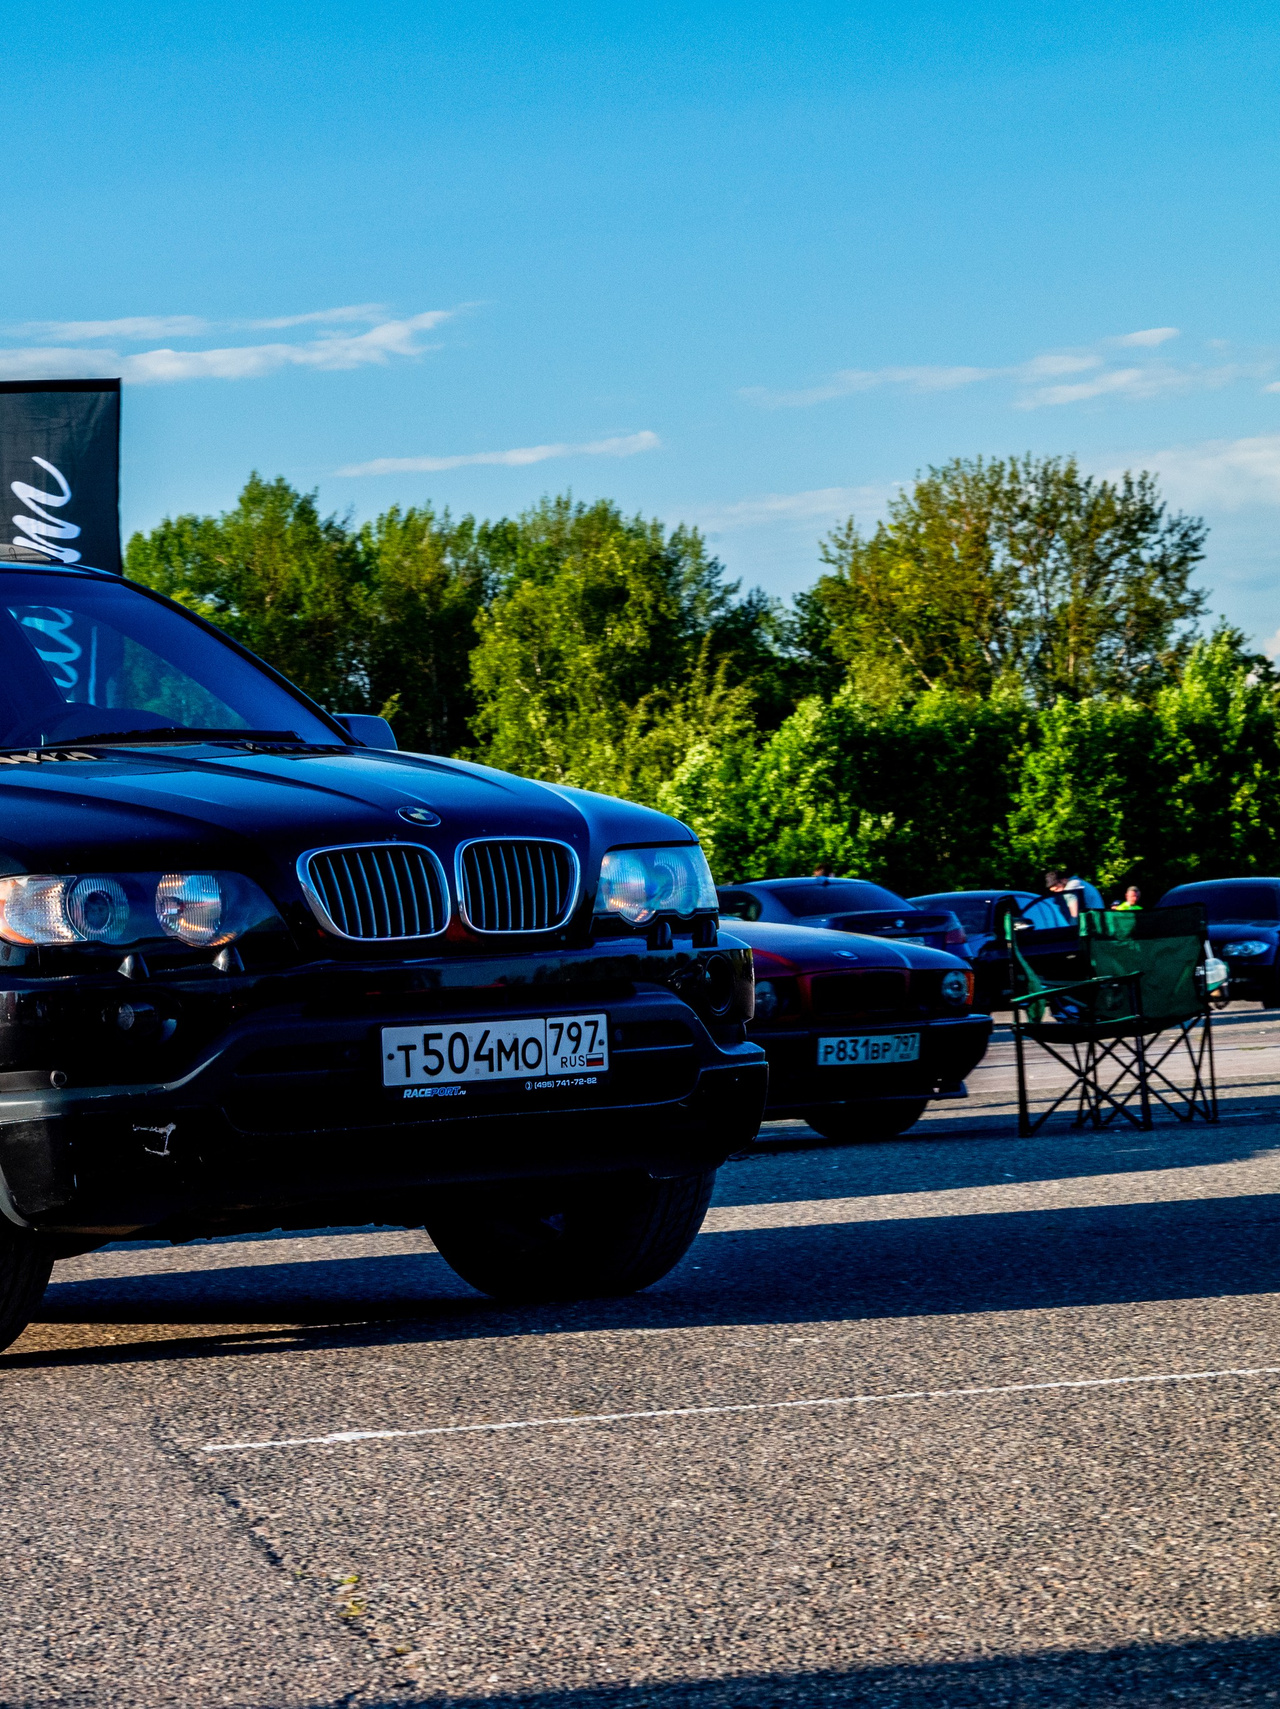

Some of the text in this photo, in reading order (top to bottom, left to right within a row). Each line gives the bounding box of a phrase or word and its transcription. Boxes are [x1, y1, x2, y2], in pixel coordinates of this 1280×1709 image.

[397, 1020, 599, 1078] Т504МО 797
[561, 1055, 585, 1068] RUS
